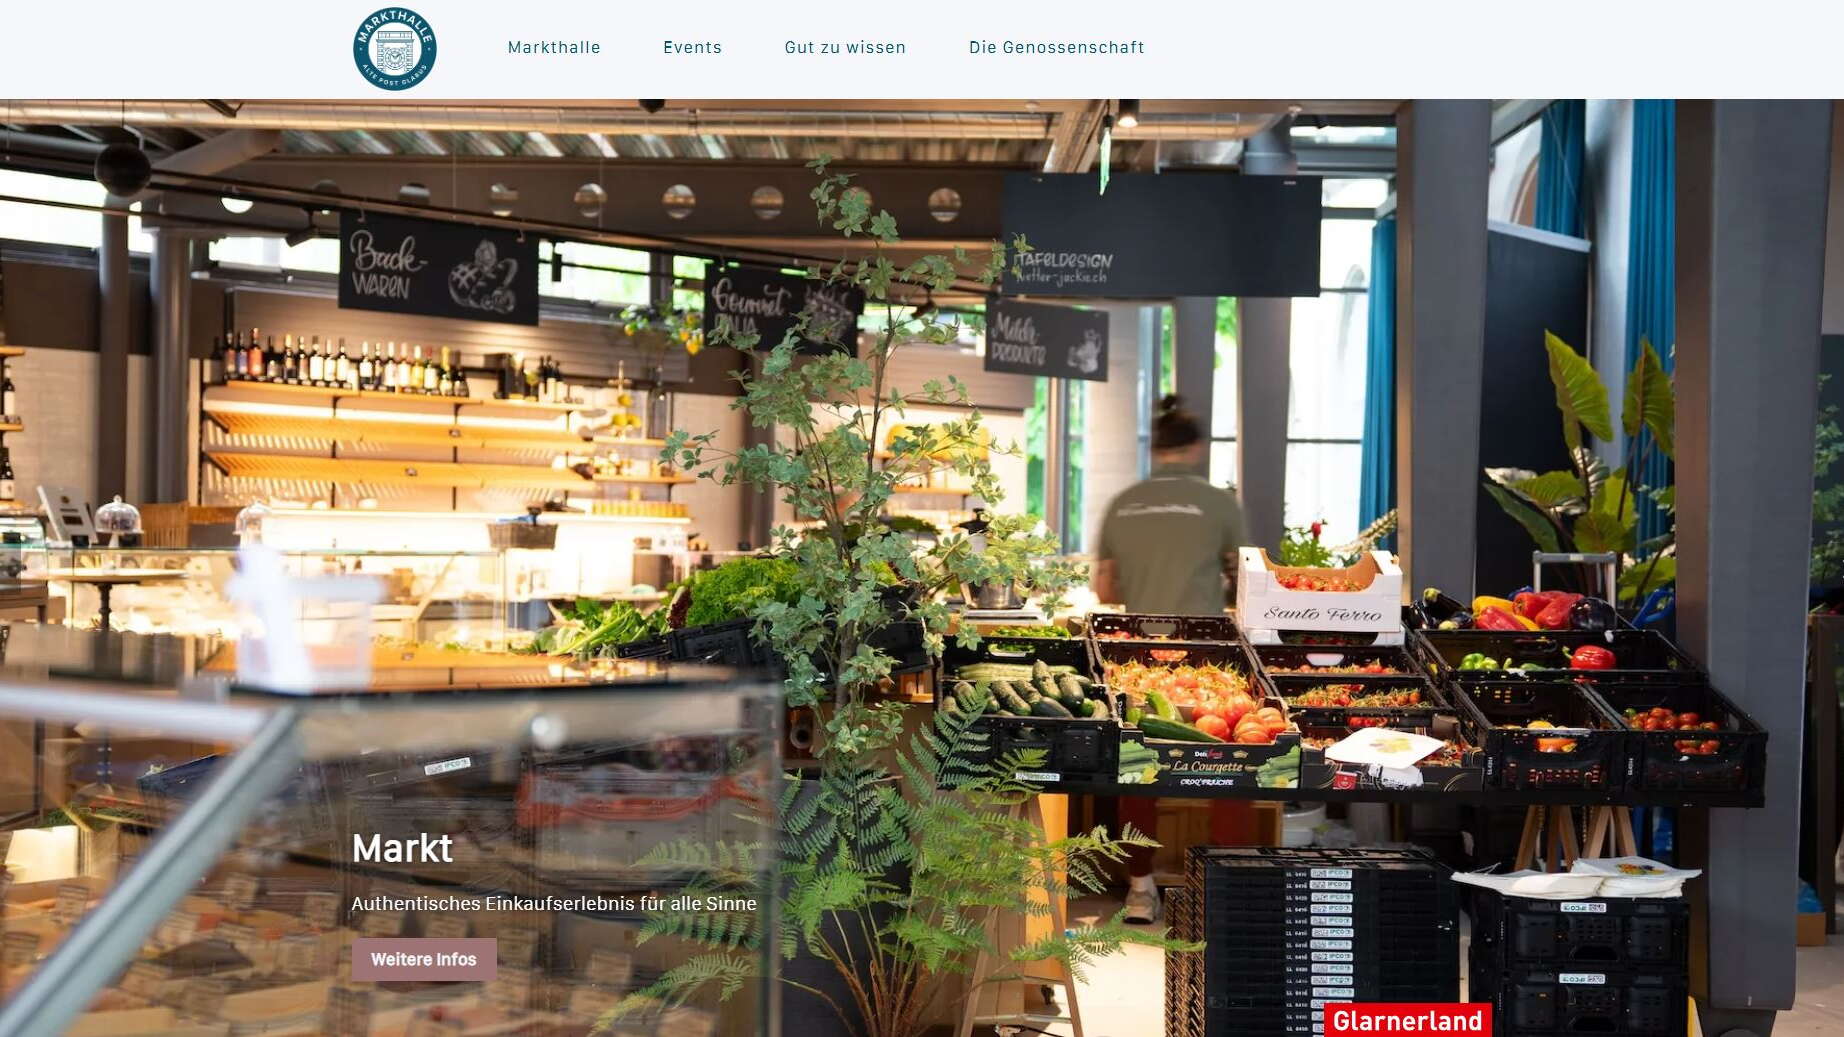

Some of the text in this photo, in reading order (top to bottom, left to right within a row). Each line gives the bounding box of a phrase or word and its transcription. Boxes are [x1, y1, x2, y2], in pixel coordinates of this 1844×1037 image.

[1264, 606, 1382, 621] Santo Ferro
[1172, 760, 1243, 773] La Courgette
